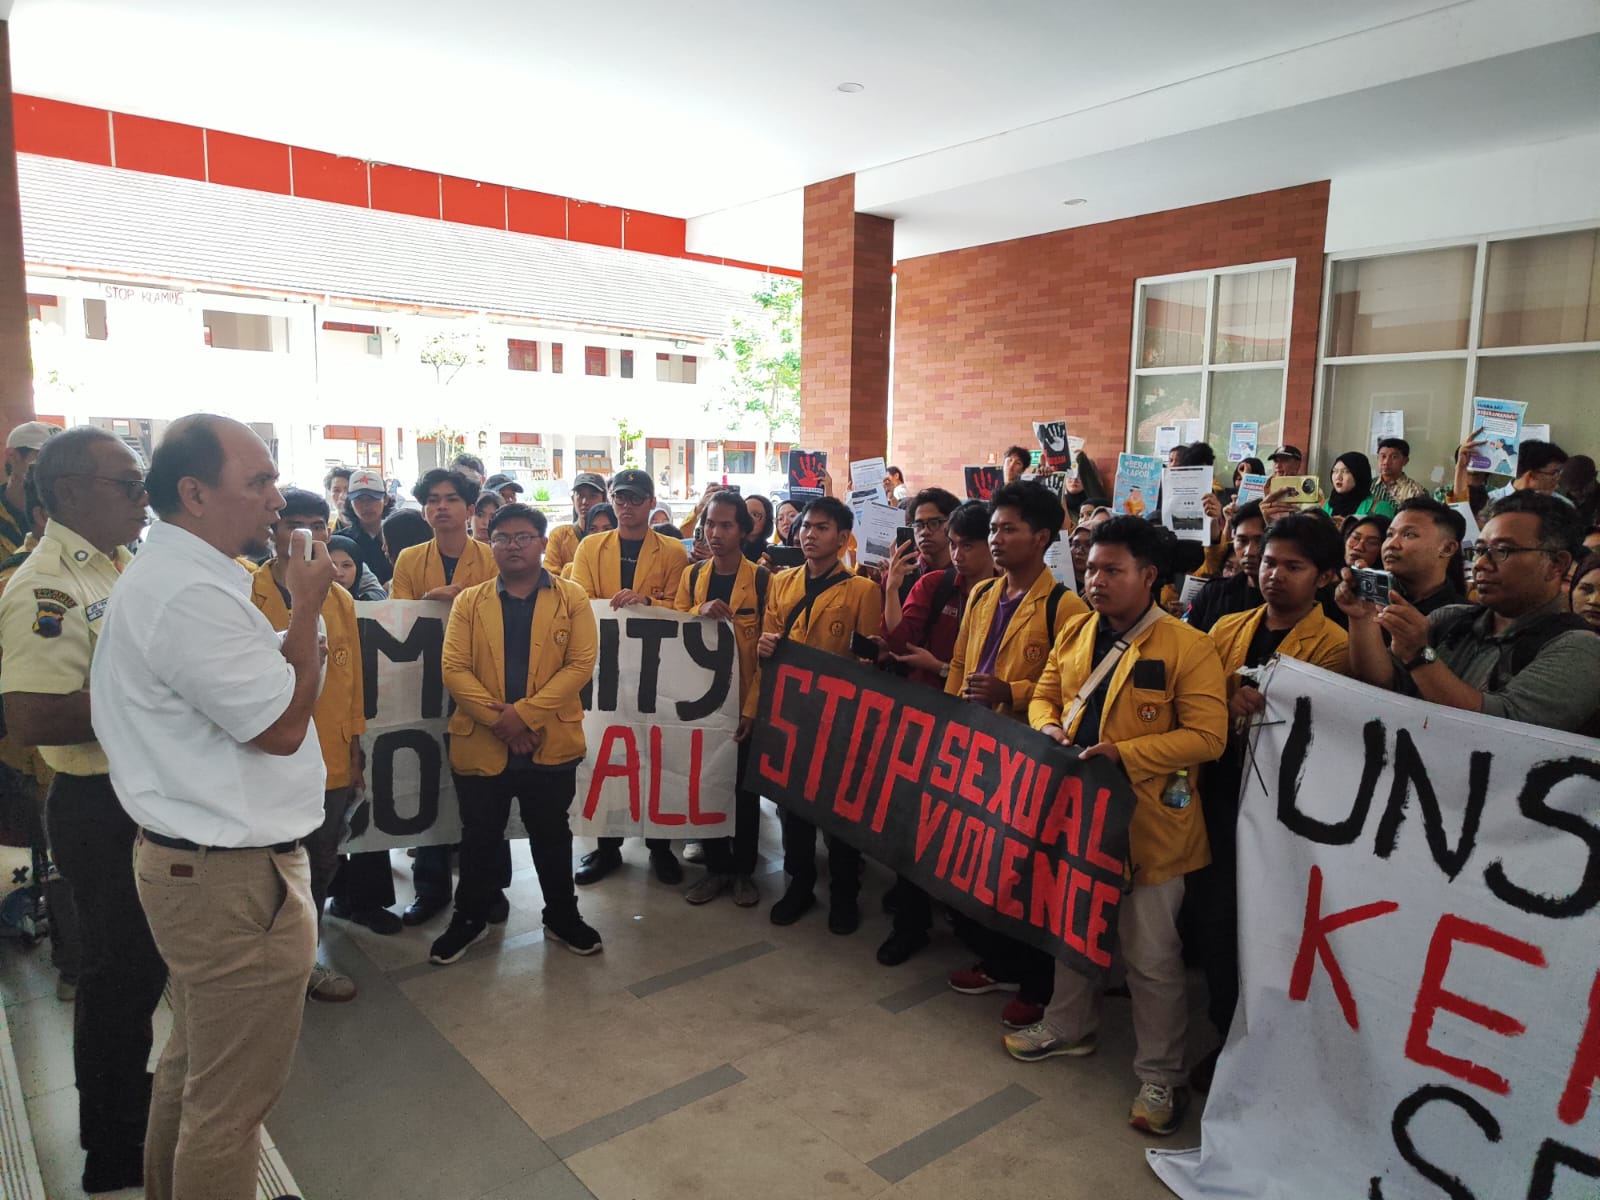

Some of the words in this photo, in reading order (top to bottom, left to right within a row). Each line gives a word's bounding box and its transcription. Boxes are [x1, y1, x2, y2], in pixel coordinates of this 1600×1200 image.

[105, 285, 135, 301] STOP
[582, 724, 728, 827] ALL
[759, 663, 936, 833] STOP
[930, 719, 1125, 876] SEXUAL
[1278, 696, 1600, 919] UNS
[915, 791, 1121, 968] VIOLENCE
